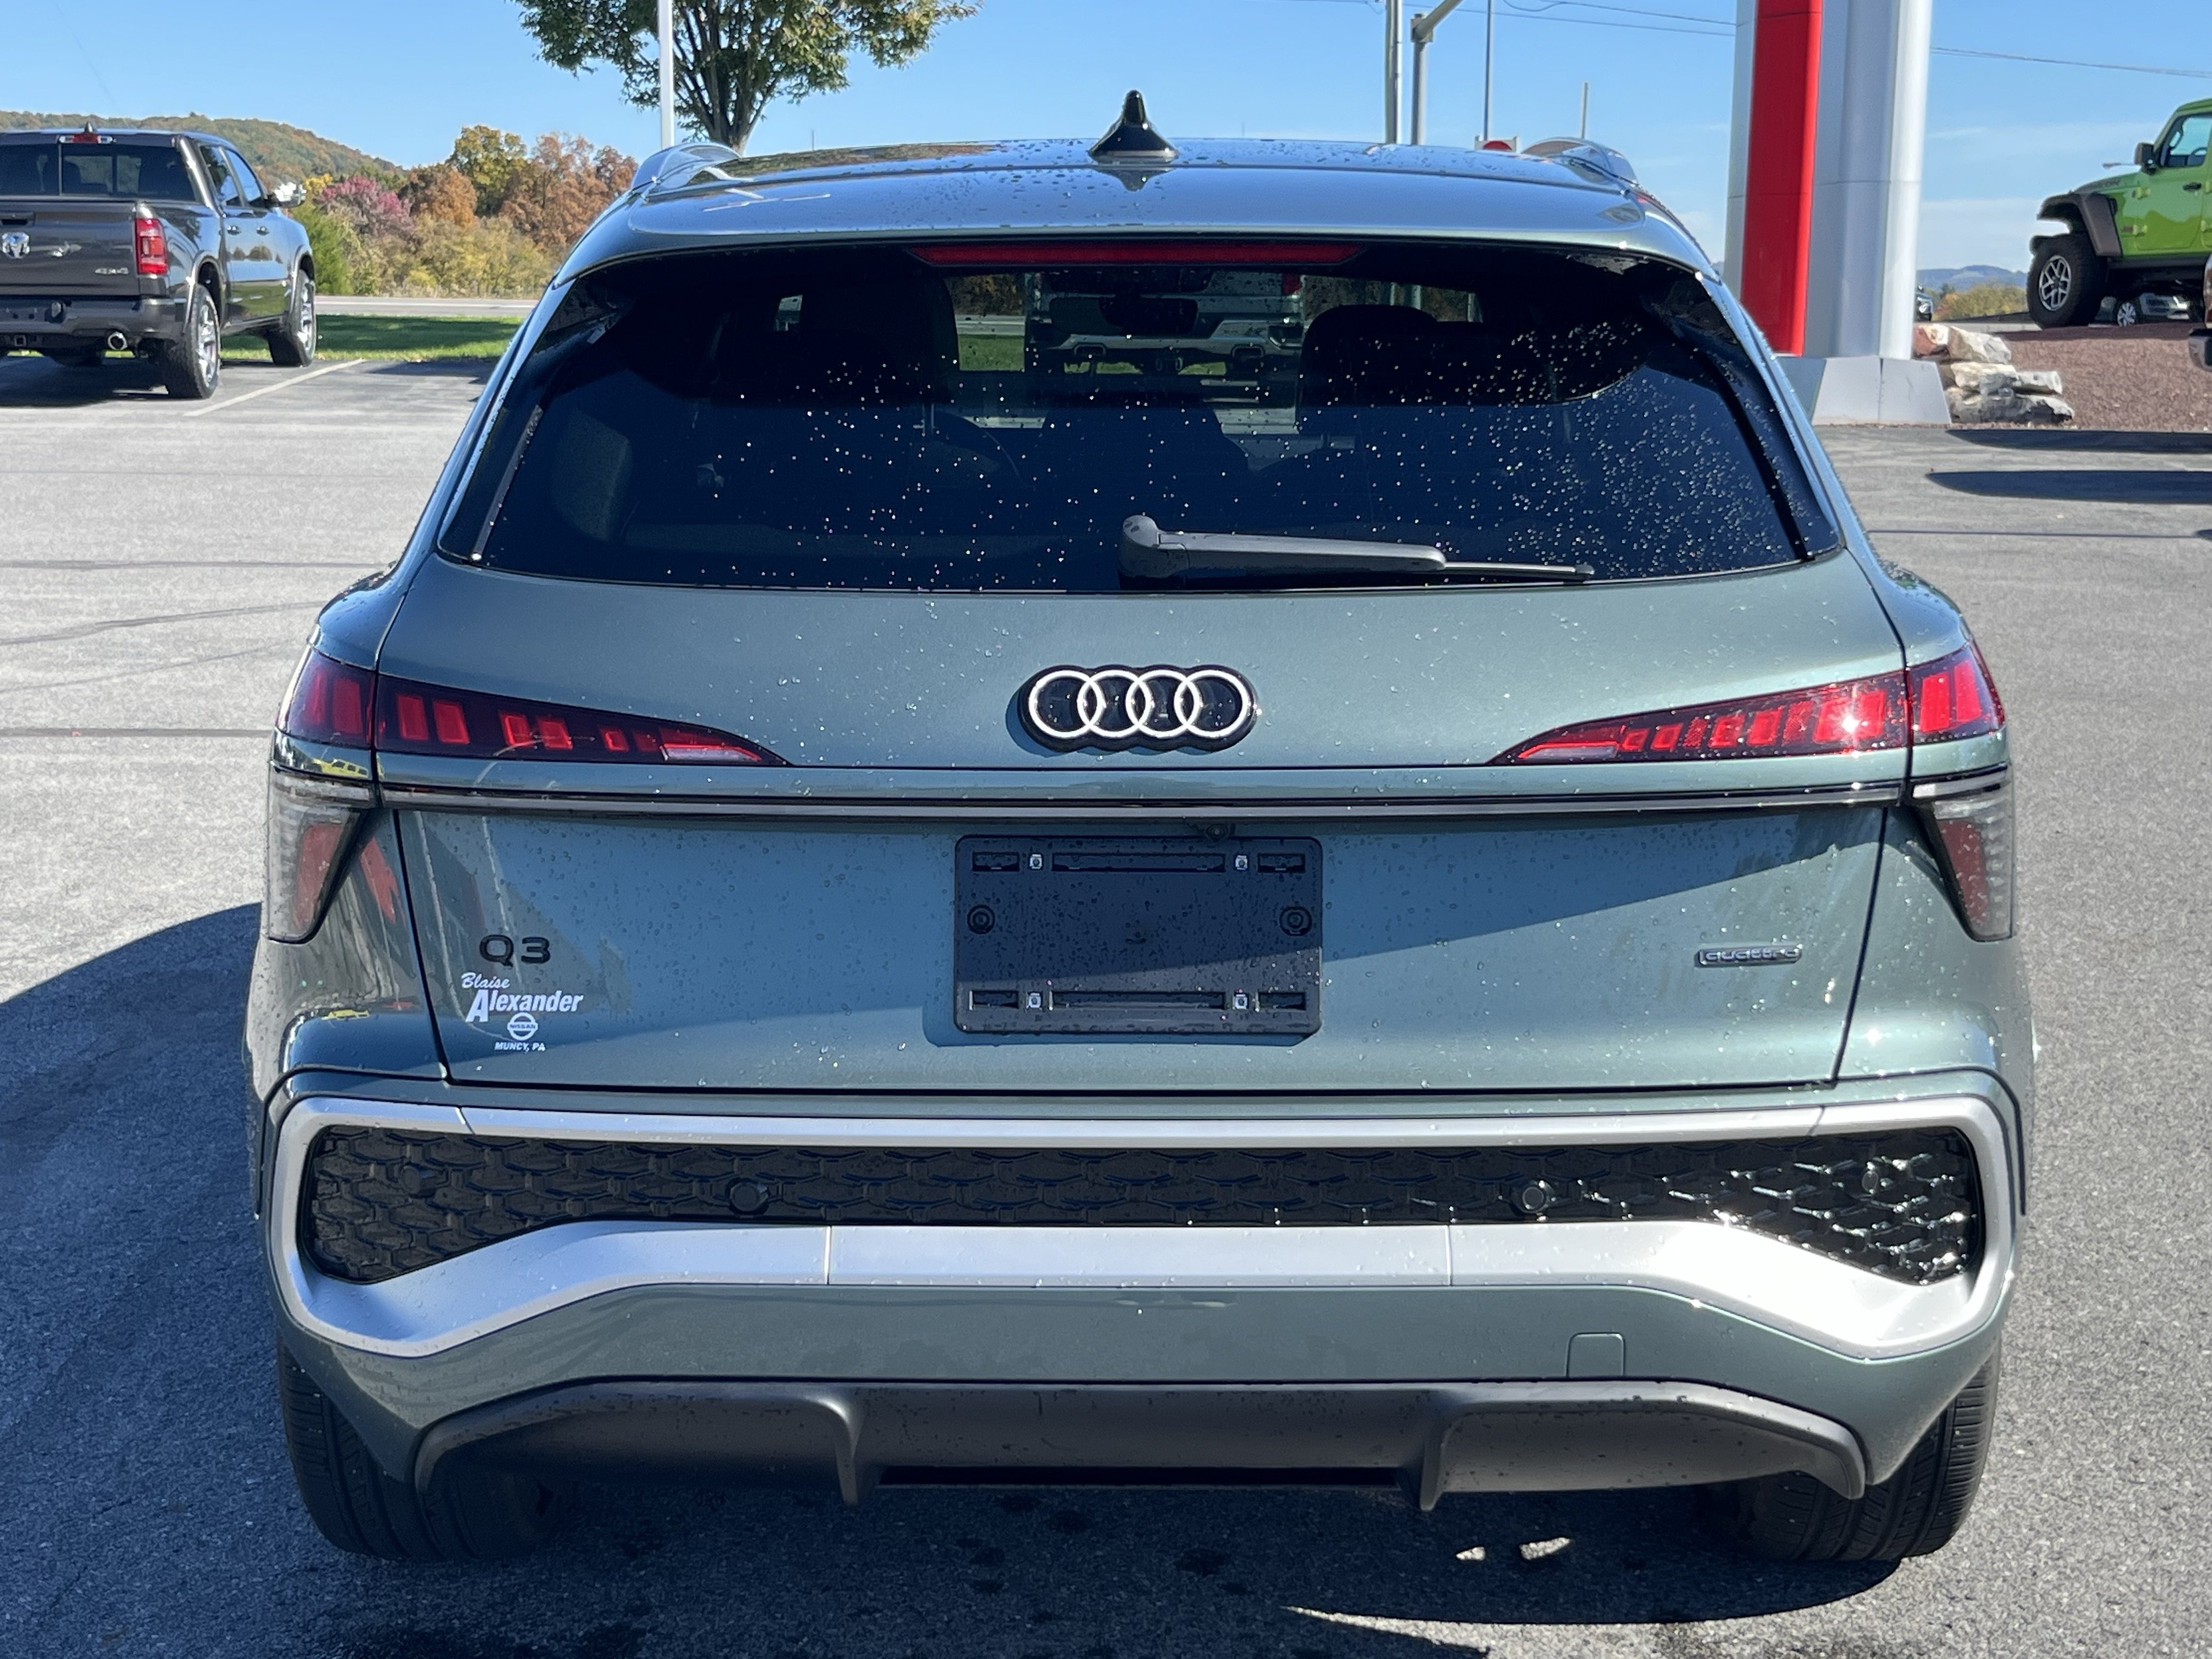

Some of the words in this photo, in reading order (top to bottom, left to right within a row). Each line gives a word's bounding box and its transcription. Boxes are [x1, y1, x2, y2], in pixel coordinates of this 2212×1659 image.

[479, 934, 551, 967] Q3
[1706, 949, 1799, 960] quattro
[461, 972, 510, 988] Blaise
[465, 989, 584, 1022] Alexander
[494, 1042, 530, 1052] MUNCY,
[532, 1042, 546, 1051] PA
